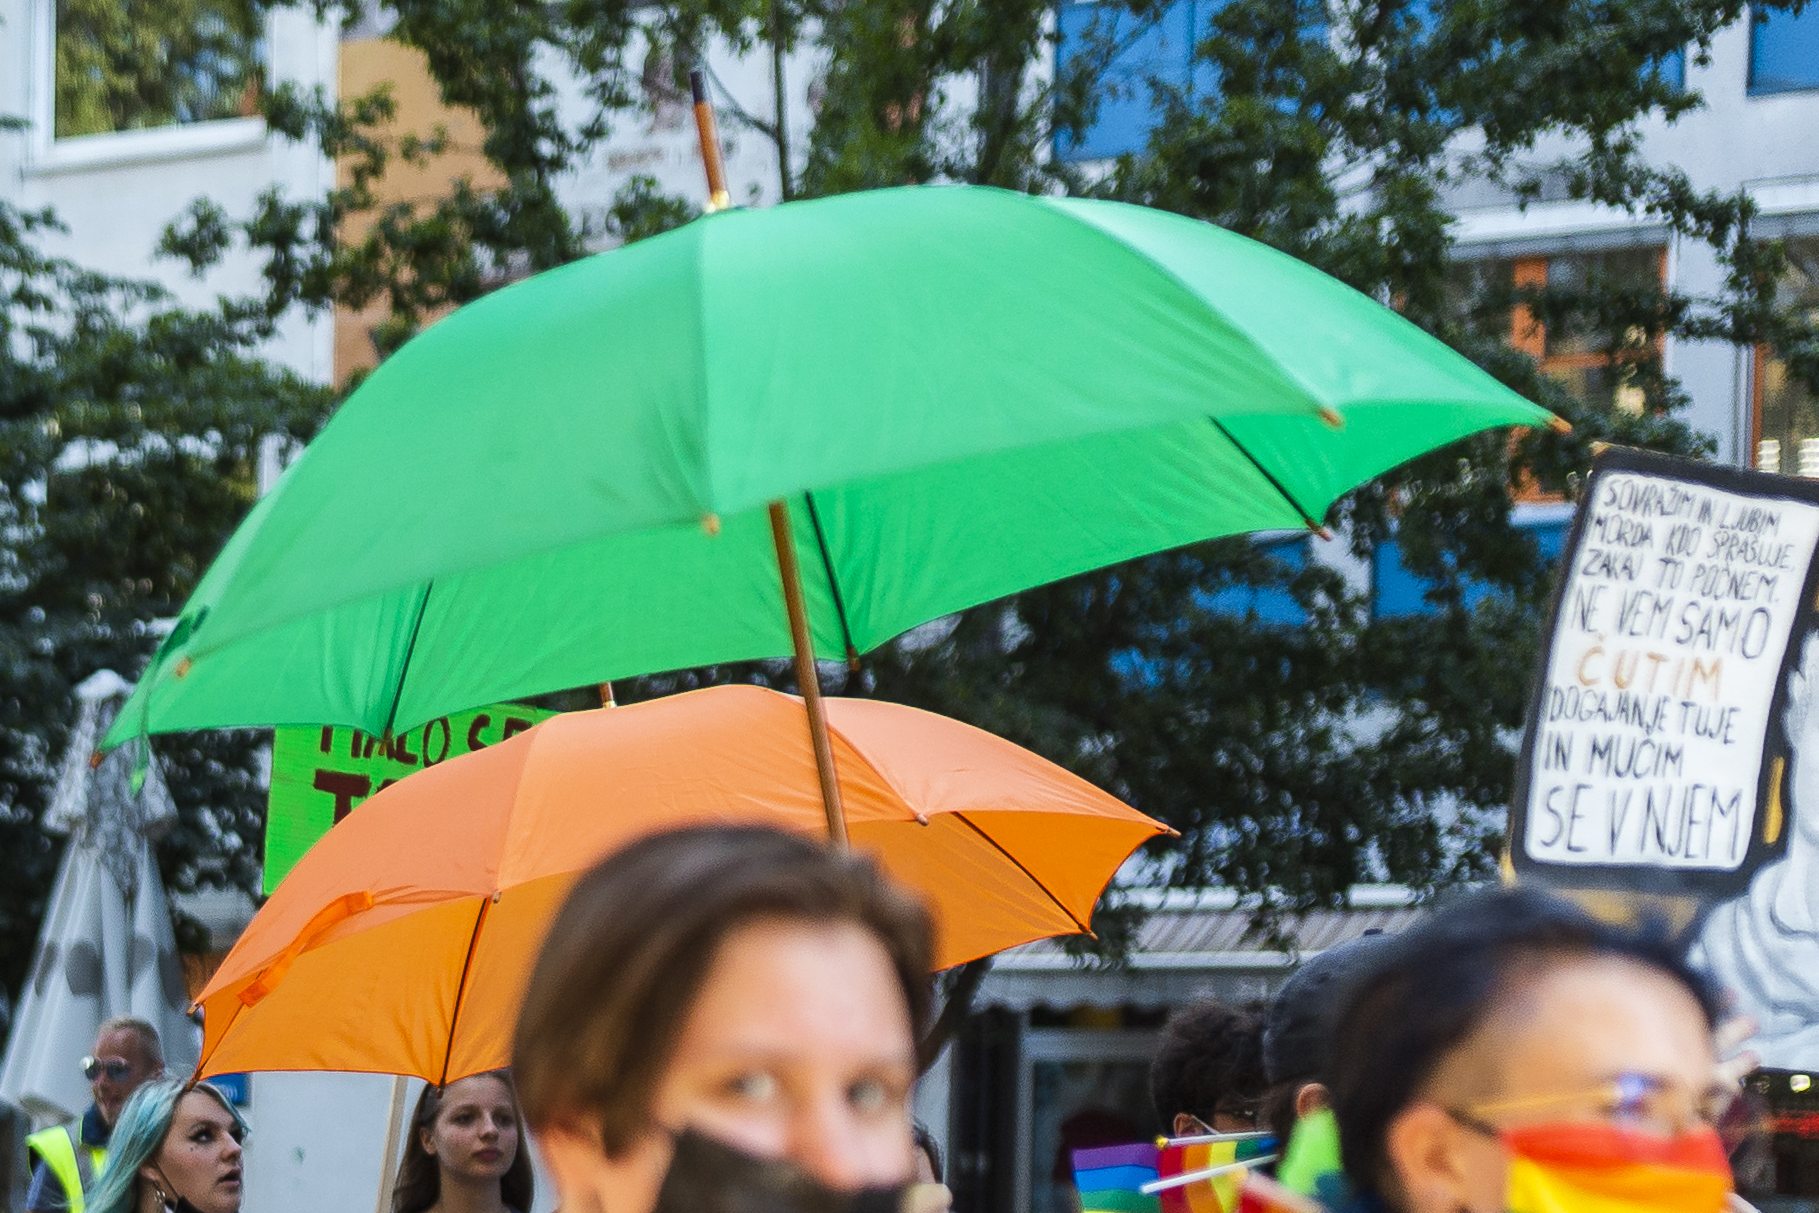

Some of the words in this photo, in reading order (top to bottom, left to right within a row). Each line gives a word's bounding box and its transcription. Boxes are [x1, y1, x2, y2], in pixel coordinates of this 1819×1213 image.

[1592, 512, 1654, 549] MORDA
[1665, 522, 1702, 558] KDO
[1697, 496, 1717, 526] IN
[1719, 503, 1782, 537] LJUBIM
[1582, 548, 1644, 582] ZAKAJ
[1657, 556, 1685, 590] TO
[1571, 584, 1609, 634] NE
[1617, 589, 1676, 640] VEM
[1675, 600, 1772, 660] SAMO
[1576, 633, 1724, 702] ČUTIM
[1549, 684, 1672, 735] DOGAJANJE
[1680, 700, 1741, 745] TUJE
[1544, 730, 1574, 772] IN
[1540, 783, 1593, 853] SE
[1609, 788, 1633, 857] V
[1638, 783, 1744, 862] NJEM
